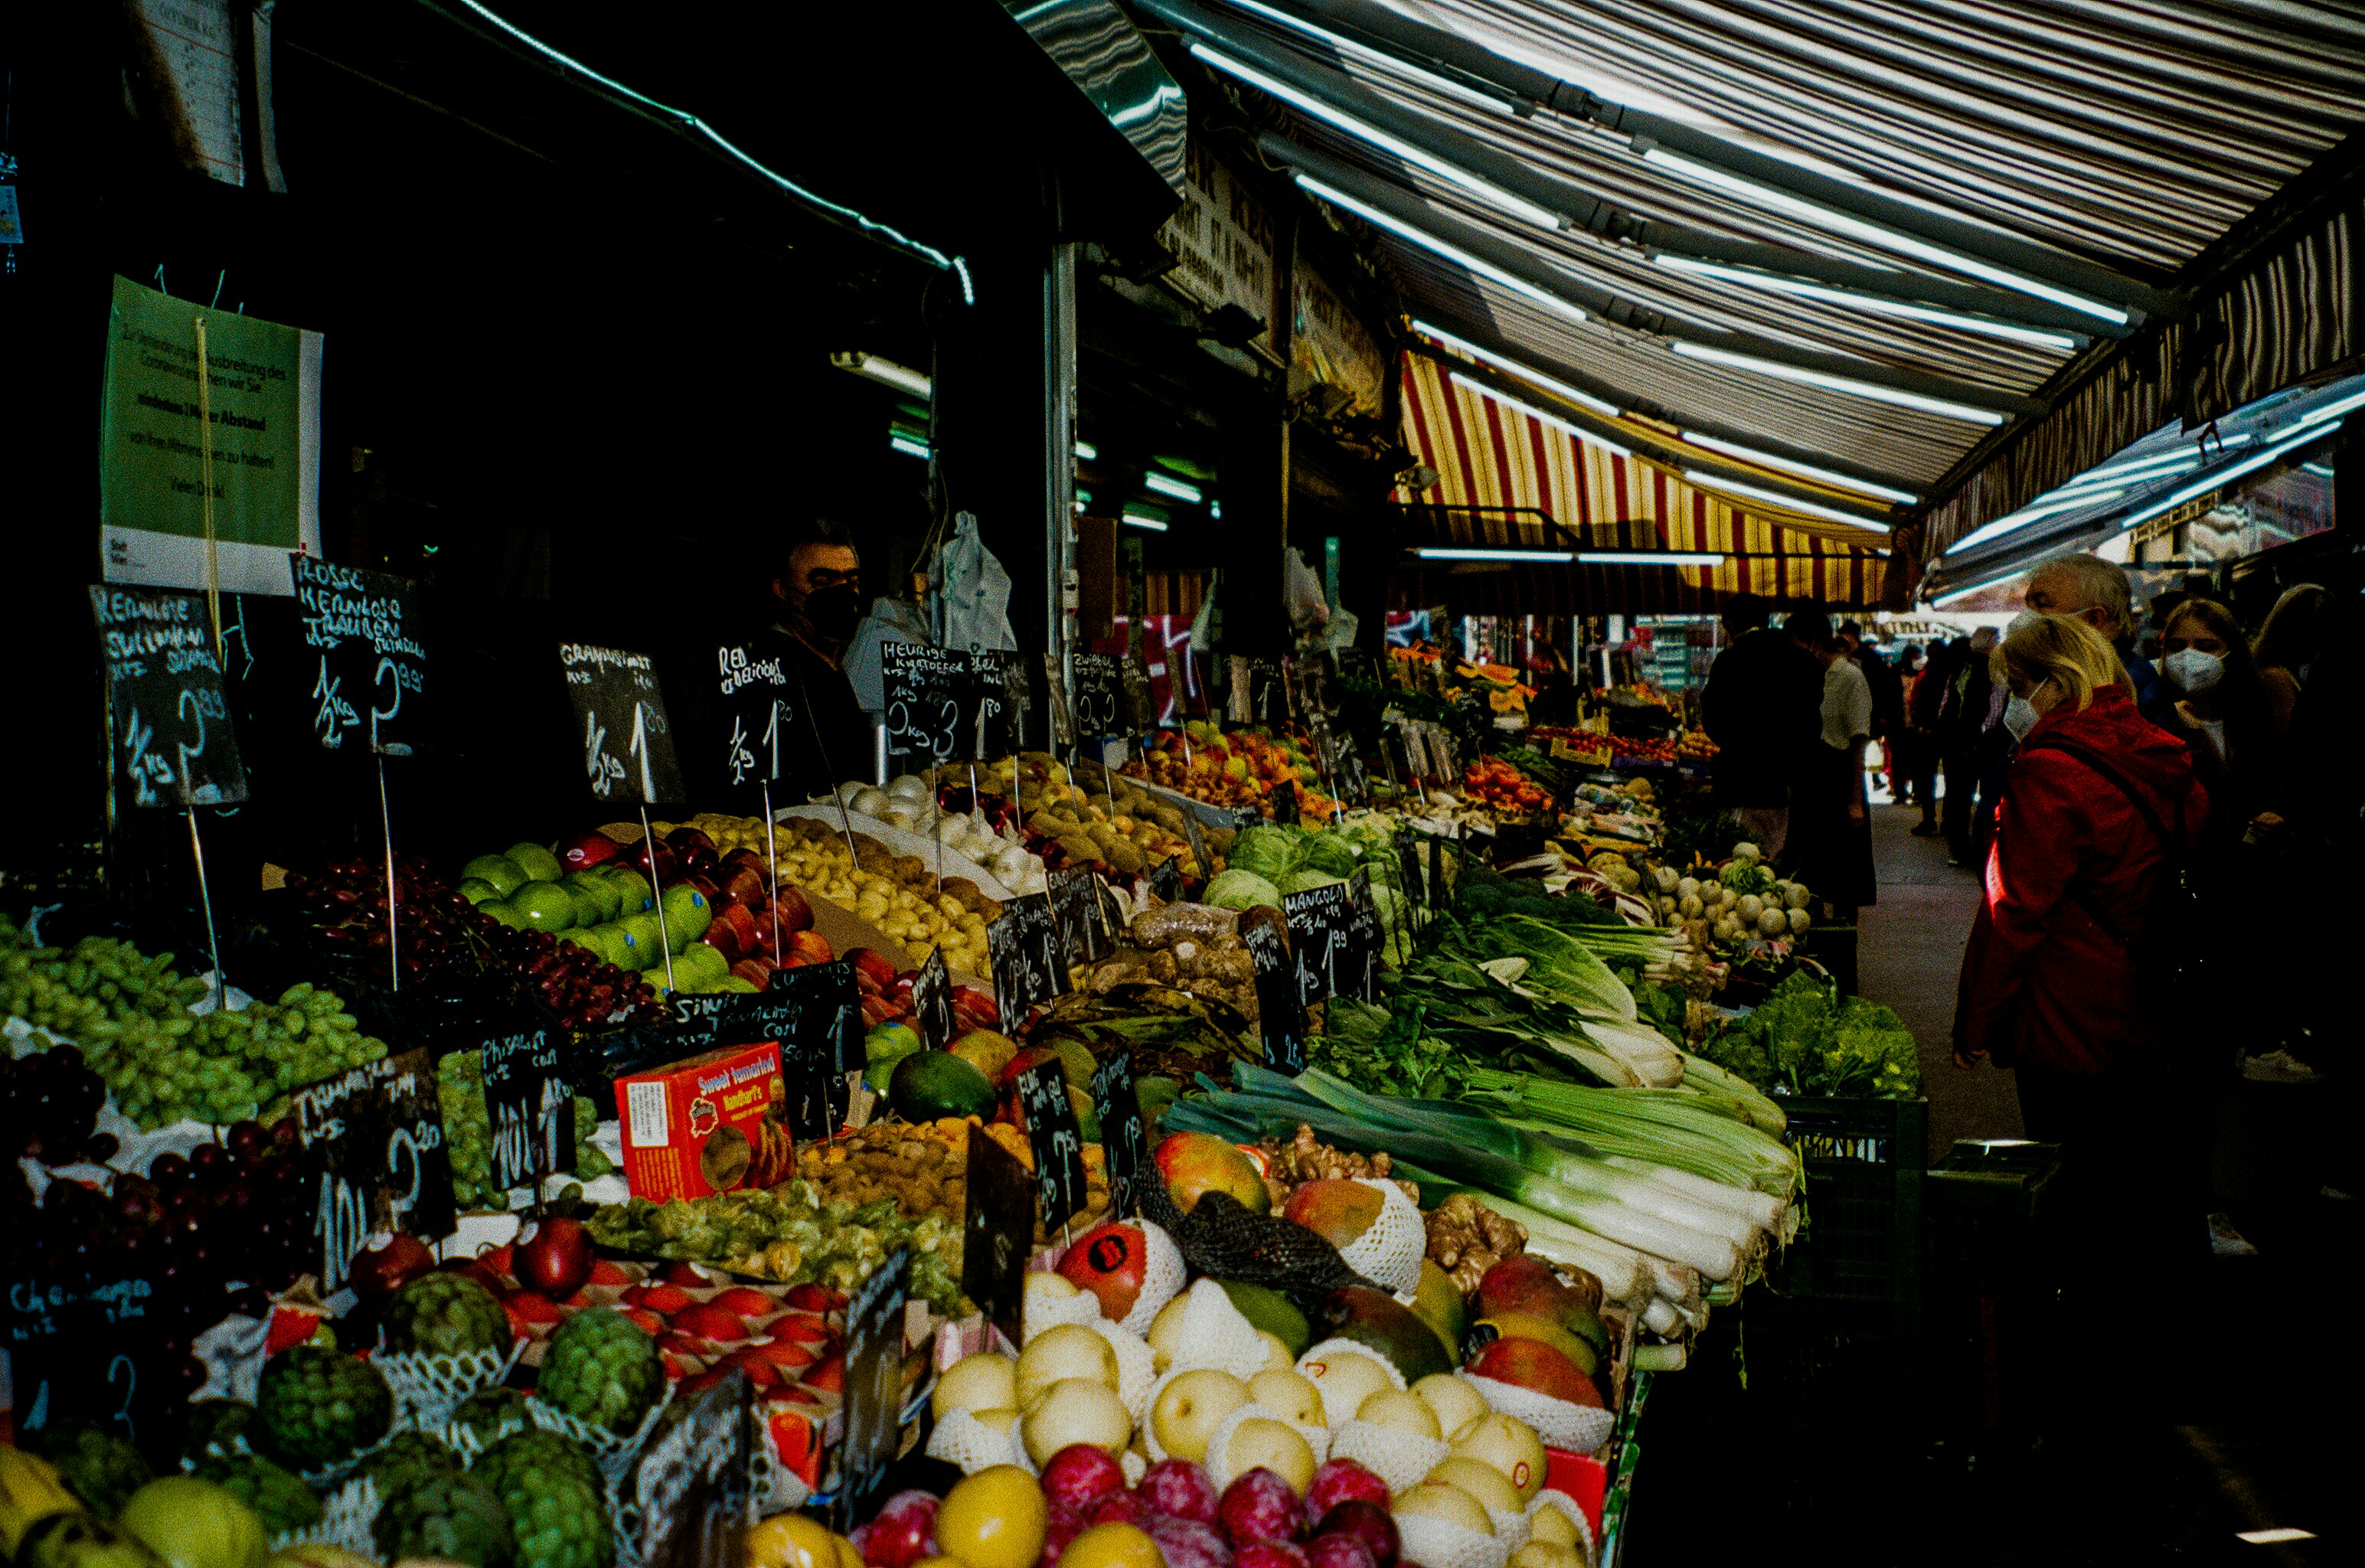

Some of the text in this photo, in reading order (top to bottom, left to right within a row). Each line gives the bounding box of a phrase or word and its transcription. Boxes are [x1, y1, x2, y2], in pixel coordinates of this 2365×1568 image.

[268, 364, 286, 381] des
[247, 377, 262, 394] Sie
[221, 410, 266, 431] Abstand
[227, 450, 240, 465] zu
[718, 645, 748, 677] RED
[932, 699, 960, 758] 3
[1285, 884, 1344, 917] MANGOLD
[697, 1069, 731, 1097] Sweet
